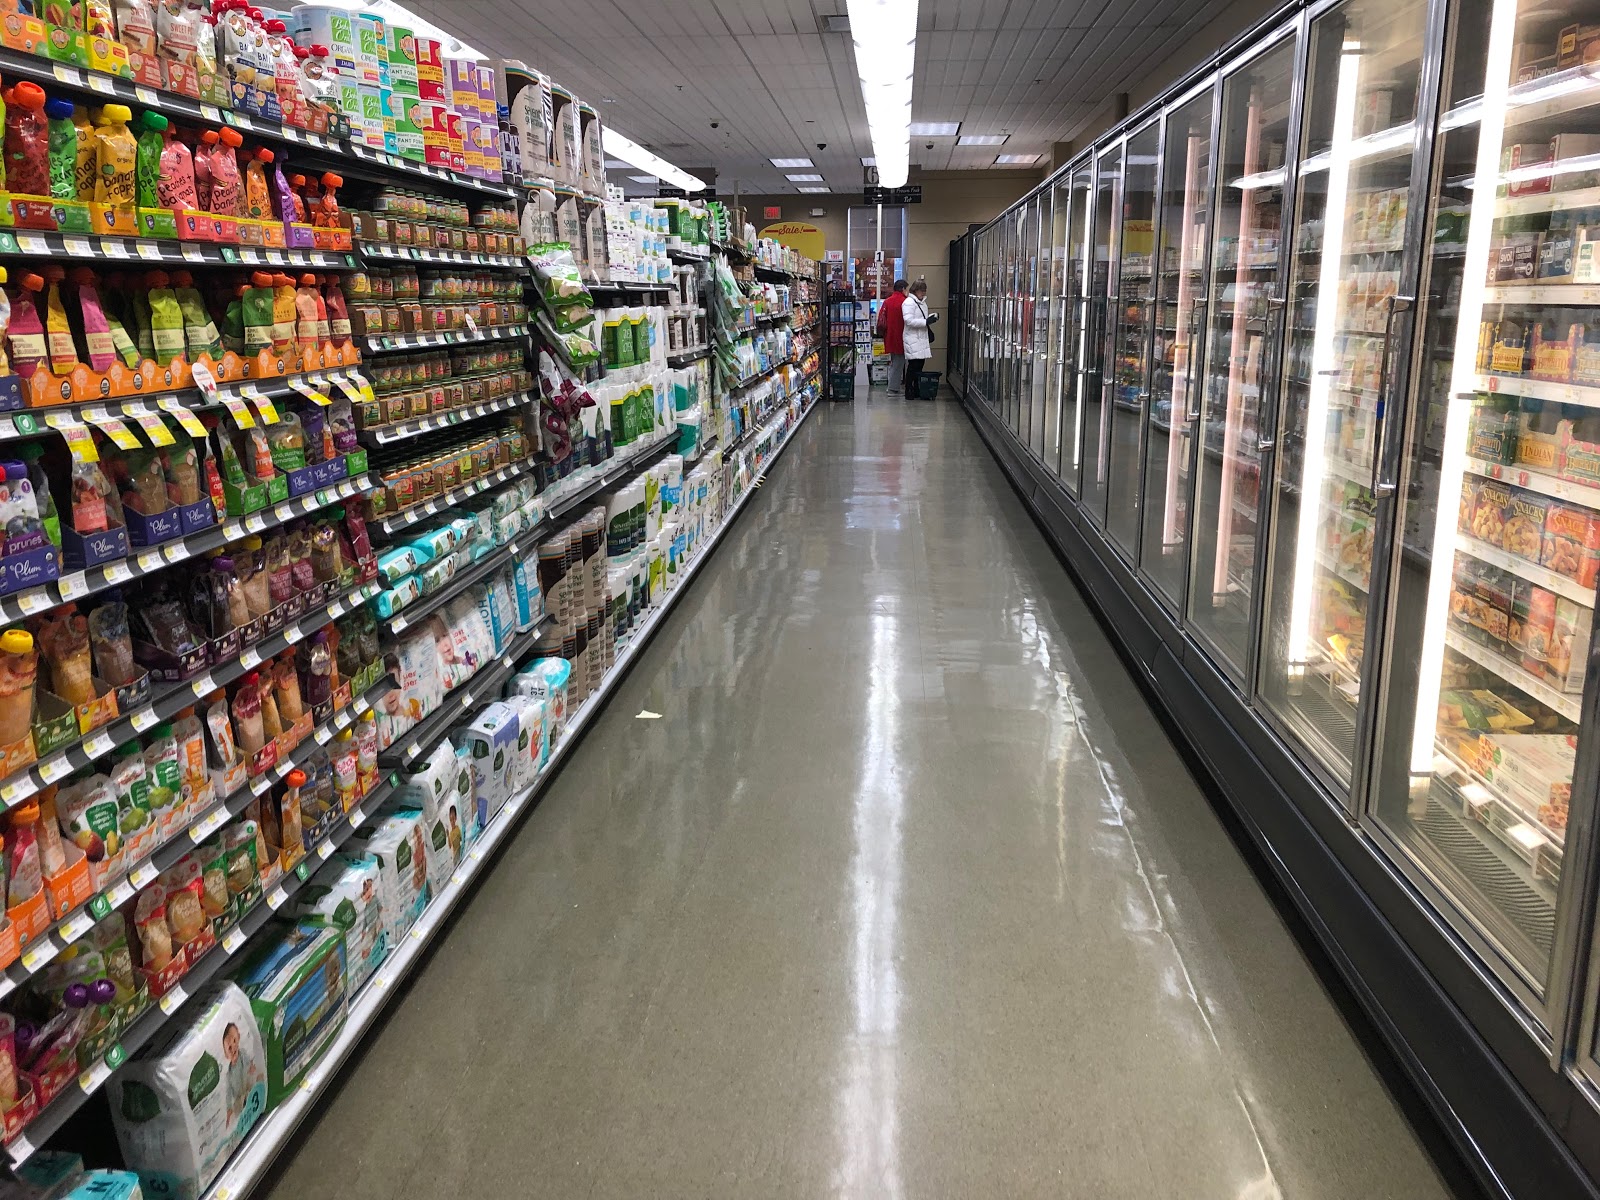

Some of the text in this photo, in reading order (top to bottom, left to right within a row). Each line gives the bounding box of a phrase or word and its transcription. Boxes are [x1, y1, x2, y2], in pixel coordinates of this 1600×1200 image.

[867, 166, 879, 184] 6
[779, 225, 804, 236] Sale!
[877, 252, 882, 262] 1
[536, 261, 551, 271] rice
[1525, 446, 1553, 462] INDIAN
[1482, 487, 1508, 509] SNACKS
[1513, 501, 1545, 524] SNACKS
[8, 536, 42, 553] prunes
[91, 538, 115, 556] Plum
[11, 560, 42, 580] Plum
